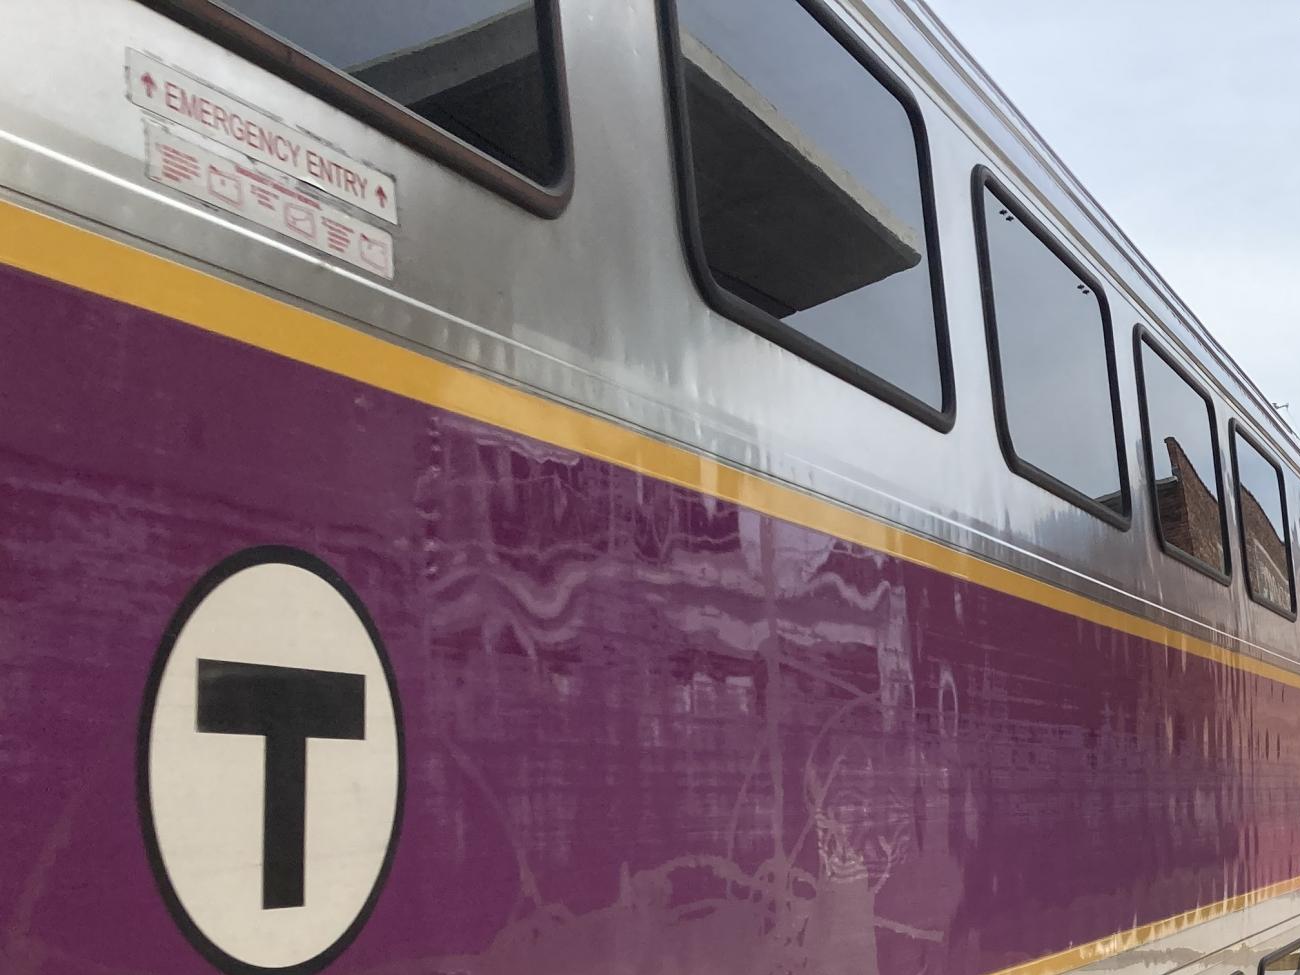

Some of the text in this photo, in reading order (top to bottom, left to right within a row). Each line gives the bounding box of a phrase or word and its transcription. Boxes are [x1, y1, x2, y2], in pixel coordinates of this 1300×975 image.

[164, 81, 301, 167] EMERGENCY
[307, 121, 369, 201] ENTRY
[196, 657, 366, 910] T
